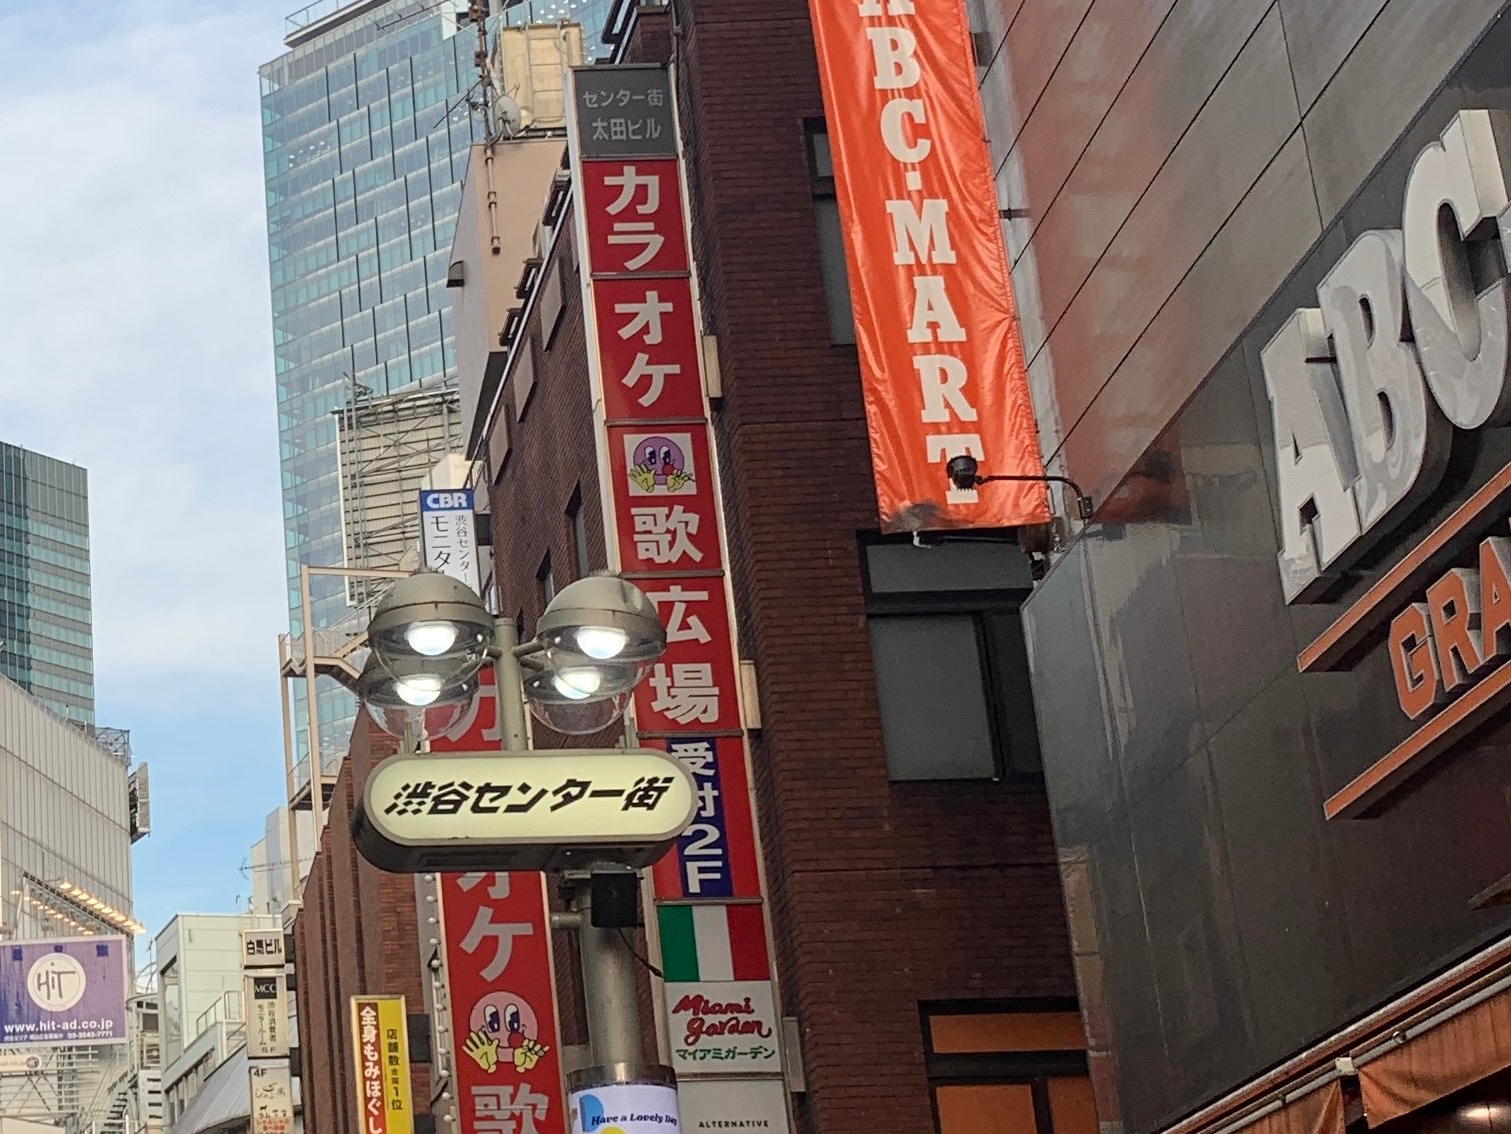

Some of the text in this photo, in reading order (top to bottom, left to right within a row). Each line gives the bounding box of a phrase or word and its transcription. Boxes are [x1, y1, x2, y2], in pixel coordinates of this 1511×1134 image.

[582, 88, 665, 109] センター街
[591, 117, 662, 142] 太田ビル
[602, 164, 682, 408] カラオケ
[426, 492, 468, 509] CBR
[383, 775, 676, 817] 渋谷センター街
[672, 993, 755, 1017] Miami
[4, 1017, 114, 1034] www.hit-ad.co.jp
[674, 1046, 777, 1061] マイアミガーデン
[359, 1005, 383, 1134] 全身もみほぐし
[590, 1114, 618, 1127] Have
[629, 1112, 664, 1125] Lovely
[697, 1119, 770, 1129] ALTERNATIVE
